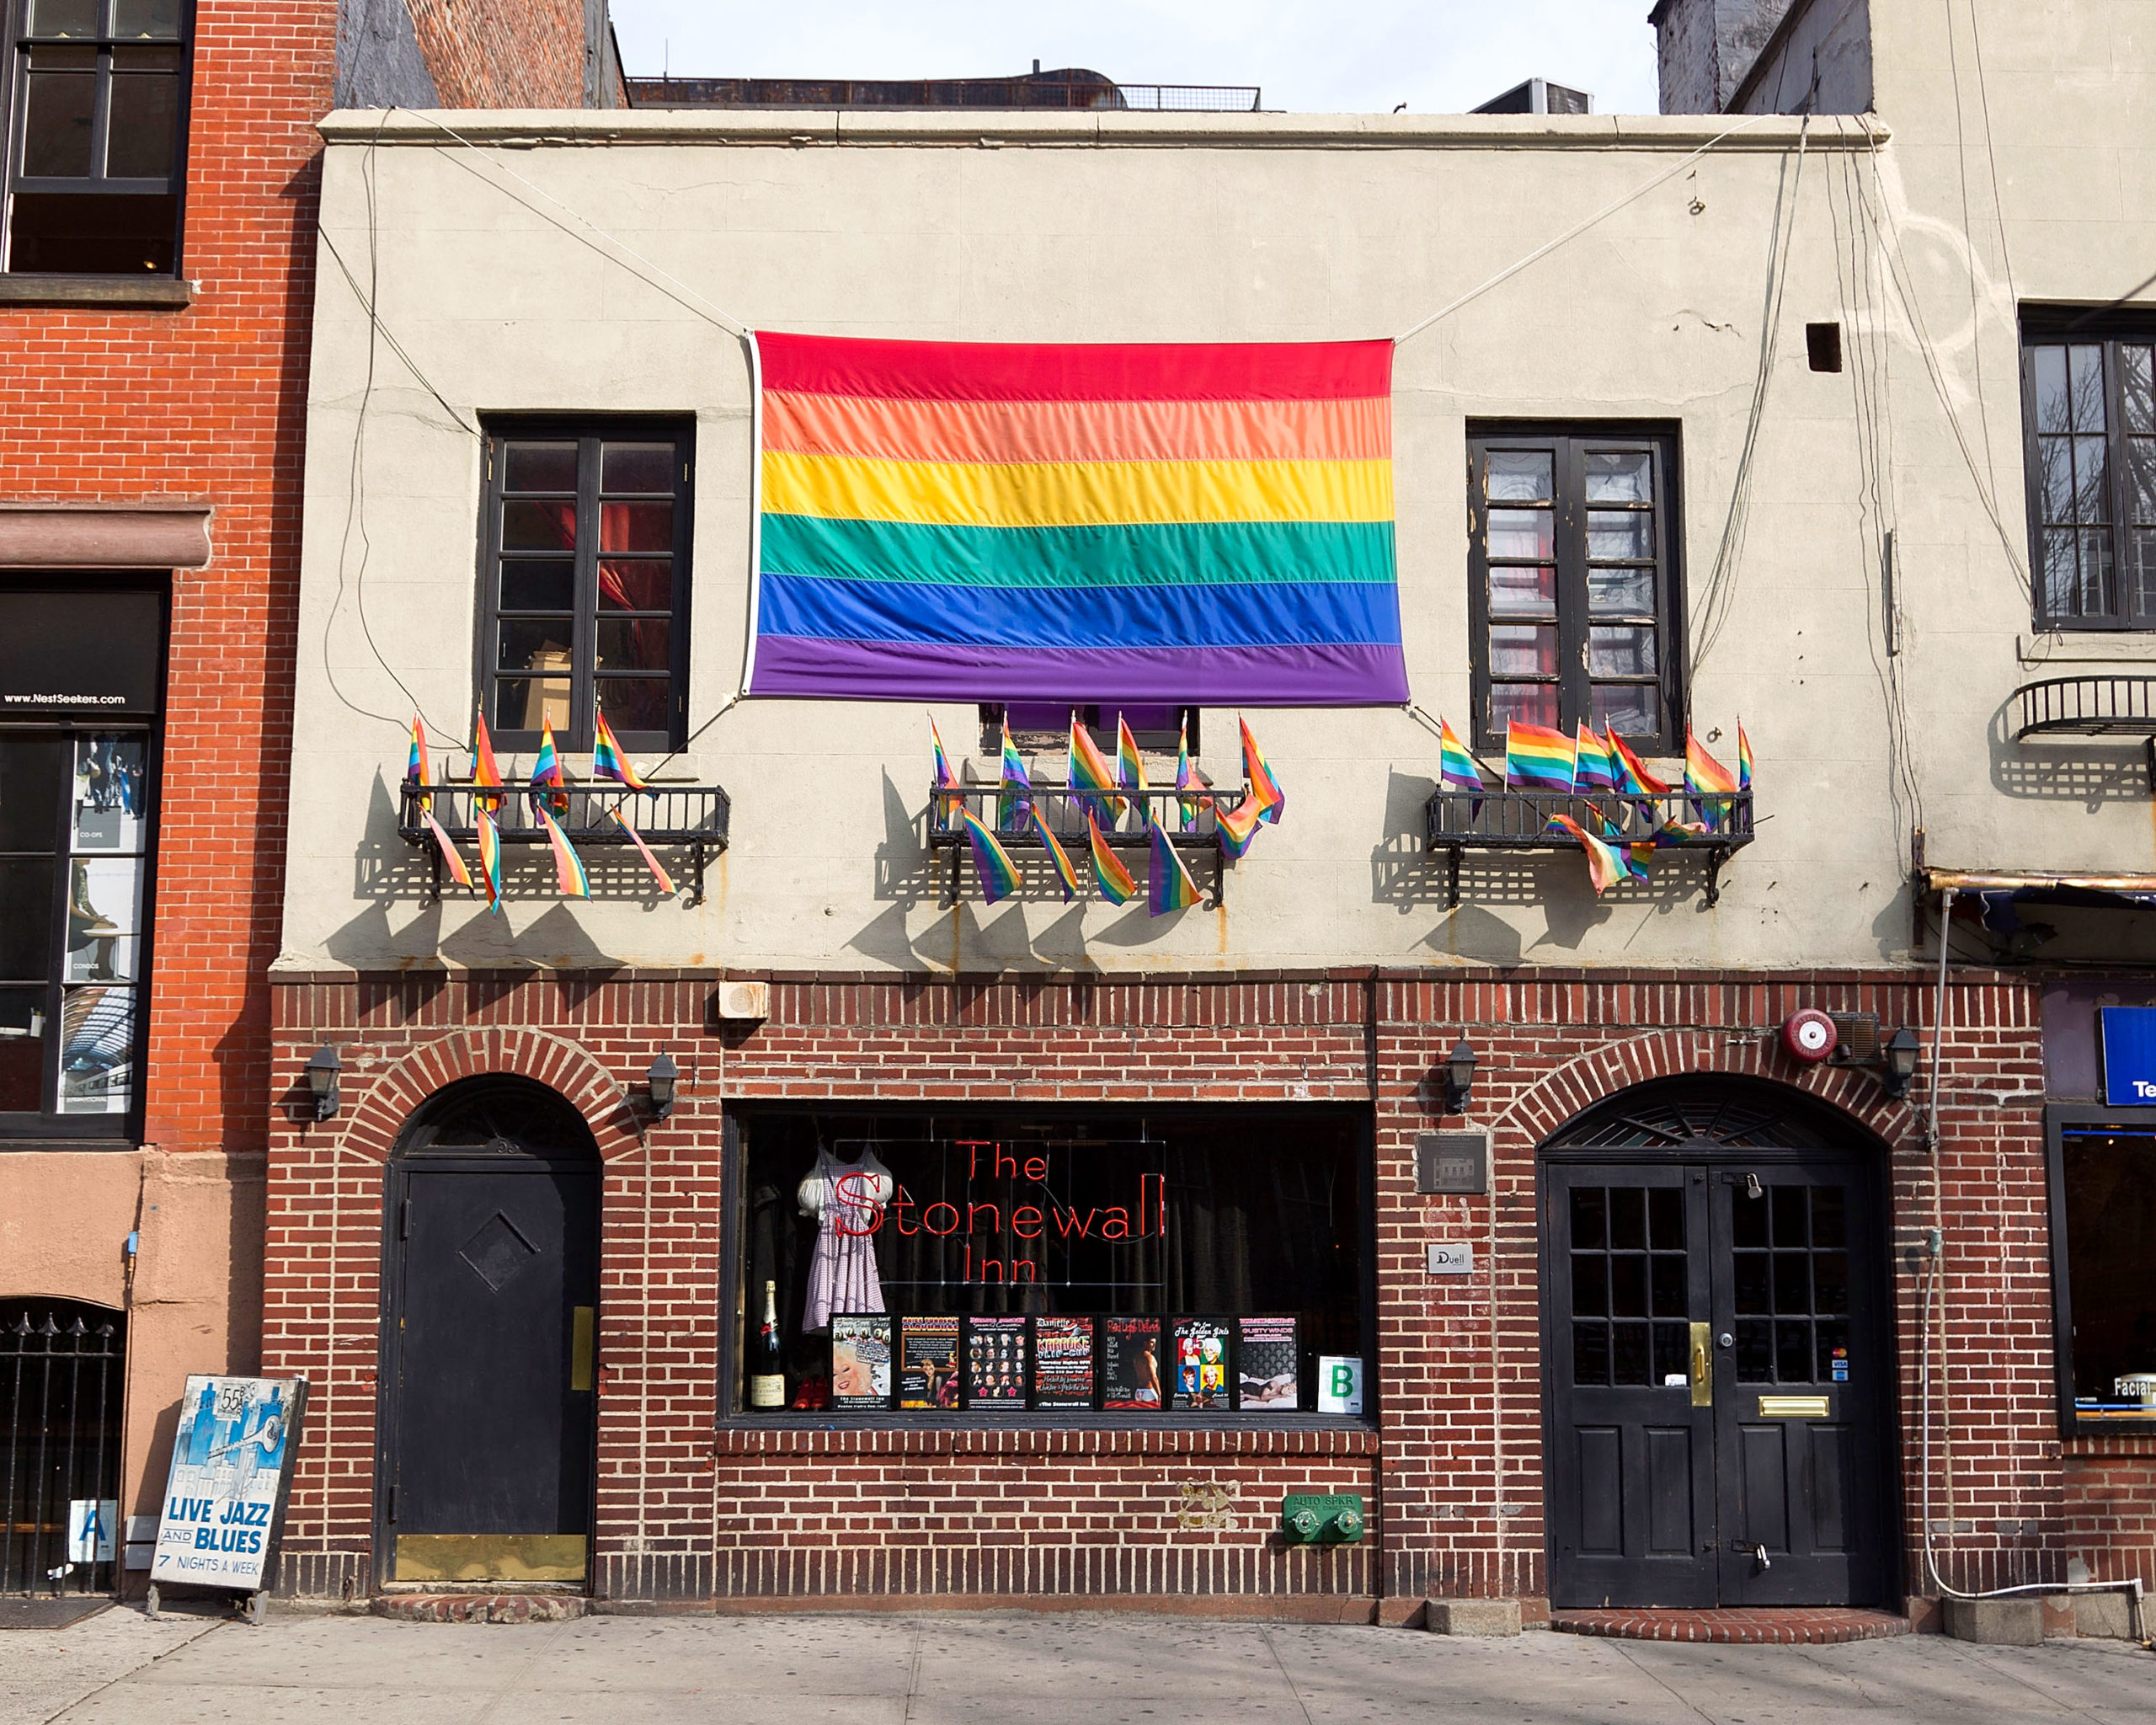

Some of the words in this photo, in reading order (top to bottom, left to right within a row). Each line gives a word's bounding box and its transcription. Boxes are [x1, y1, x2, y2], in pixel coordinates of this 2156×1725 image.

[4, 693, 125, 704] www.NestSeekers.com
[955, 1140, 1046, 1180] The
[835, 1172, 1165, 1238] Stonewall
[965, 1245, 1035, 1284] Inn
[1437, 1252, 1465, 1263] Duell
[1037, 1317, 1070, 1327] Danielle
[1175, 1327, 1188, 1337] The
[1189, 1326, 1212, 1338] Golden
[1213, 1327, 1229, 1338] Girls
[835, 1328, 891, 1343] BINGO
[1037, 1336, 1091, 1352] KARAOKE
[1331, 1365, 1353, 1398] B
[2114, 1377, 2151, 1396] Facial
[221, 1388, 240, 1411] 55
[1293, 1496, 1321, 1505] AUTO
[1325, 1496, 1353, 1505] SPKR
[168, 1497, 214, 1523] LIVE
[220, 1501, 270, 1527] JAZZ
[78, 1509, 106, 1541] A
[163, 1530, 192, 1541] AND
[195, 1527, 262, 1554] BLUES
[157, 1555, 171, 1567] 7
[177, 1556, 219, 1572] NIGHTS
[221, 1560, 228, 1573] A
[232, 1561, 259, 1575] WEEK
